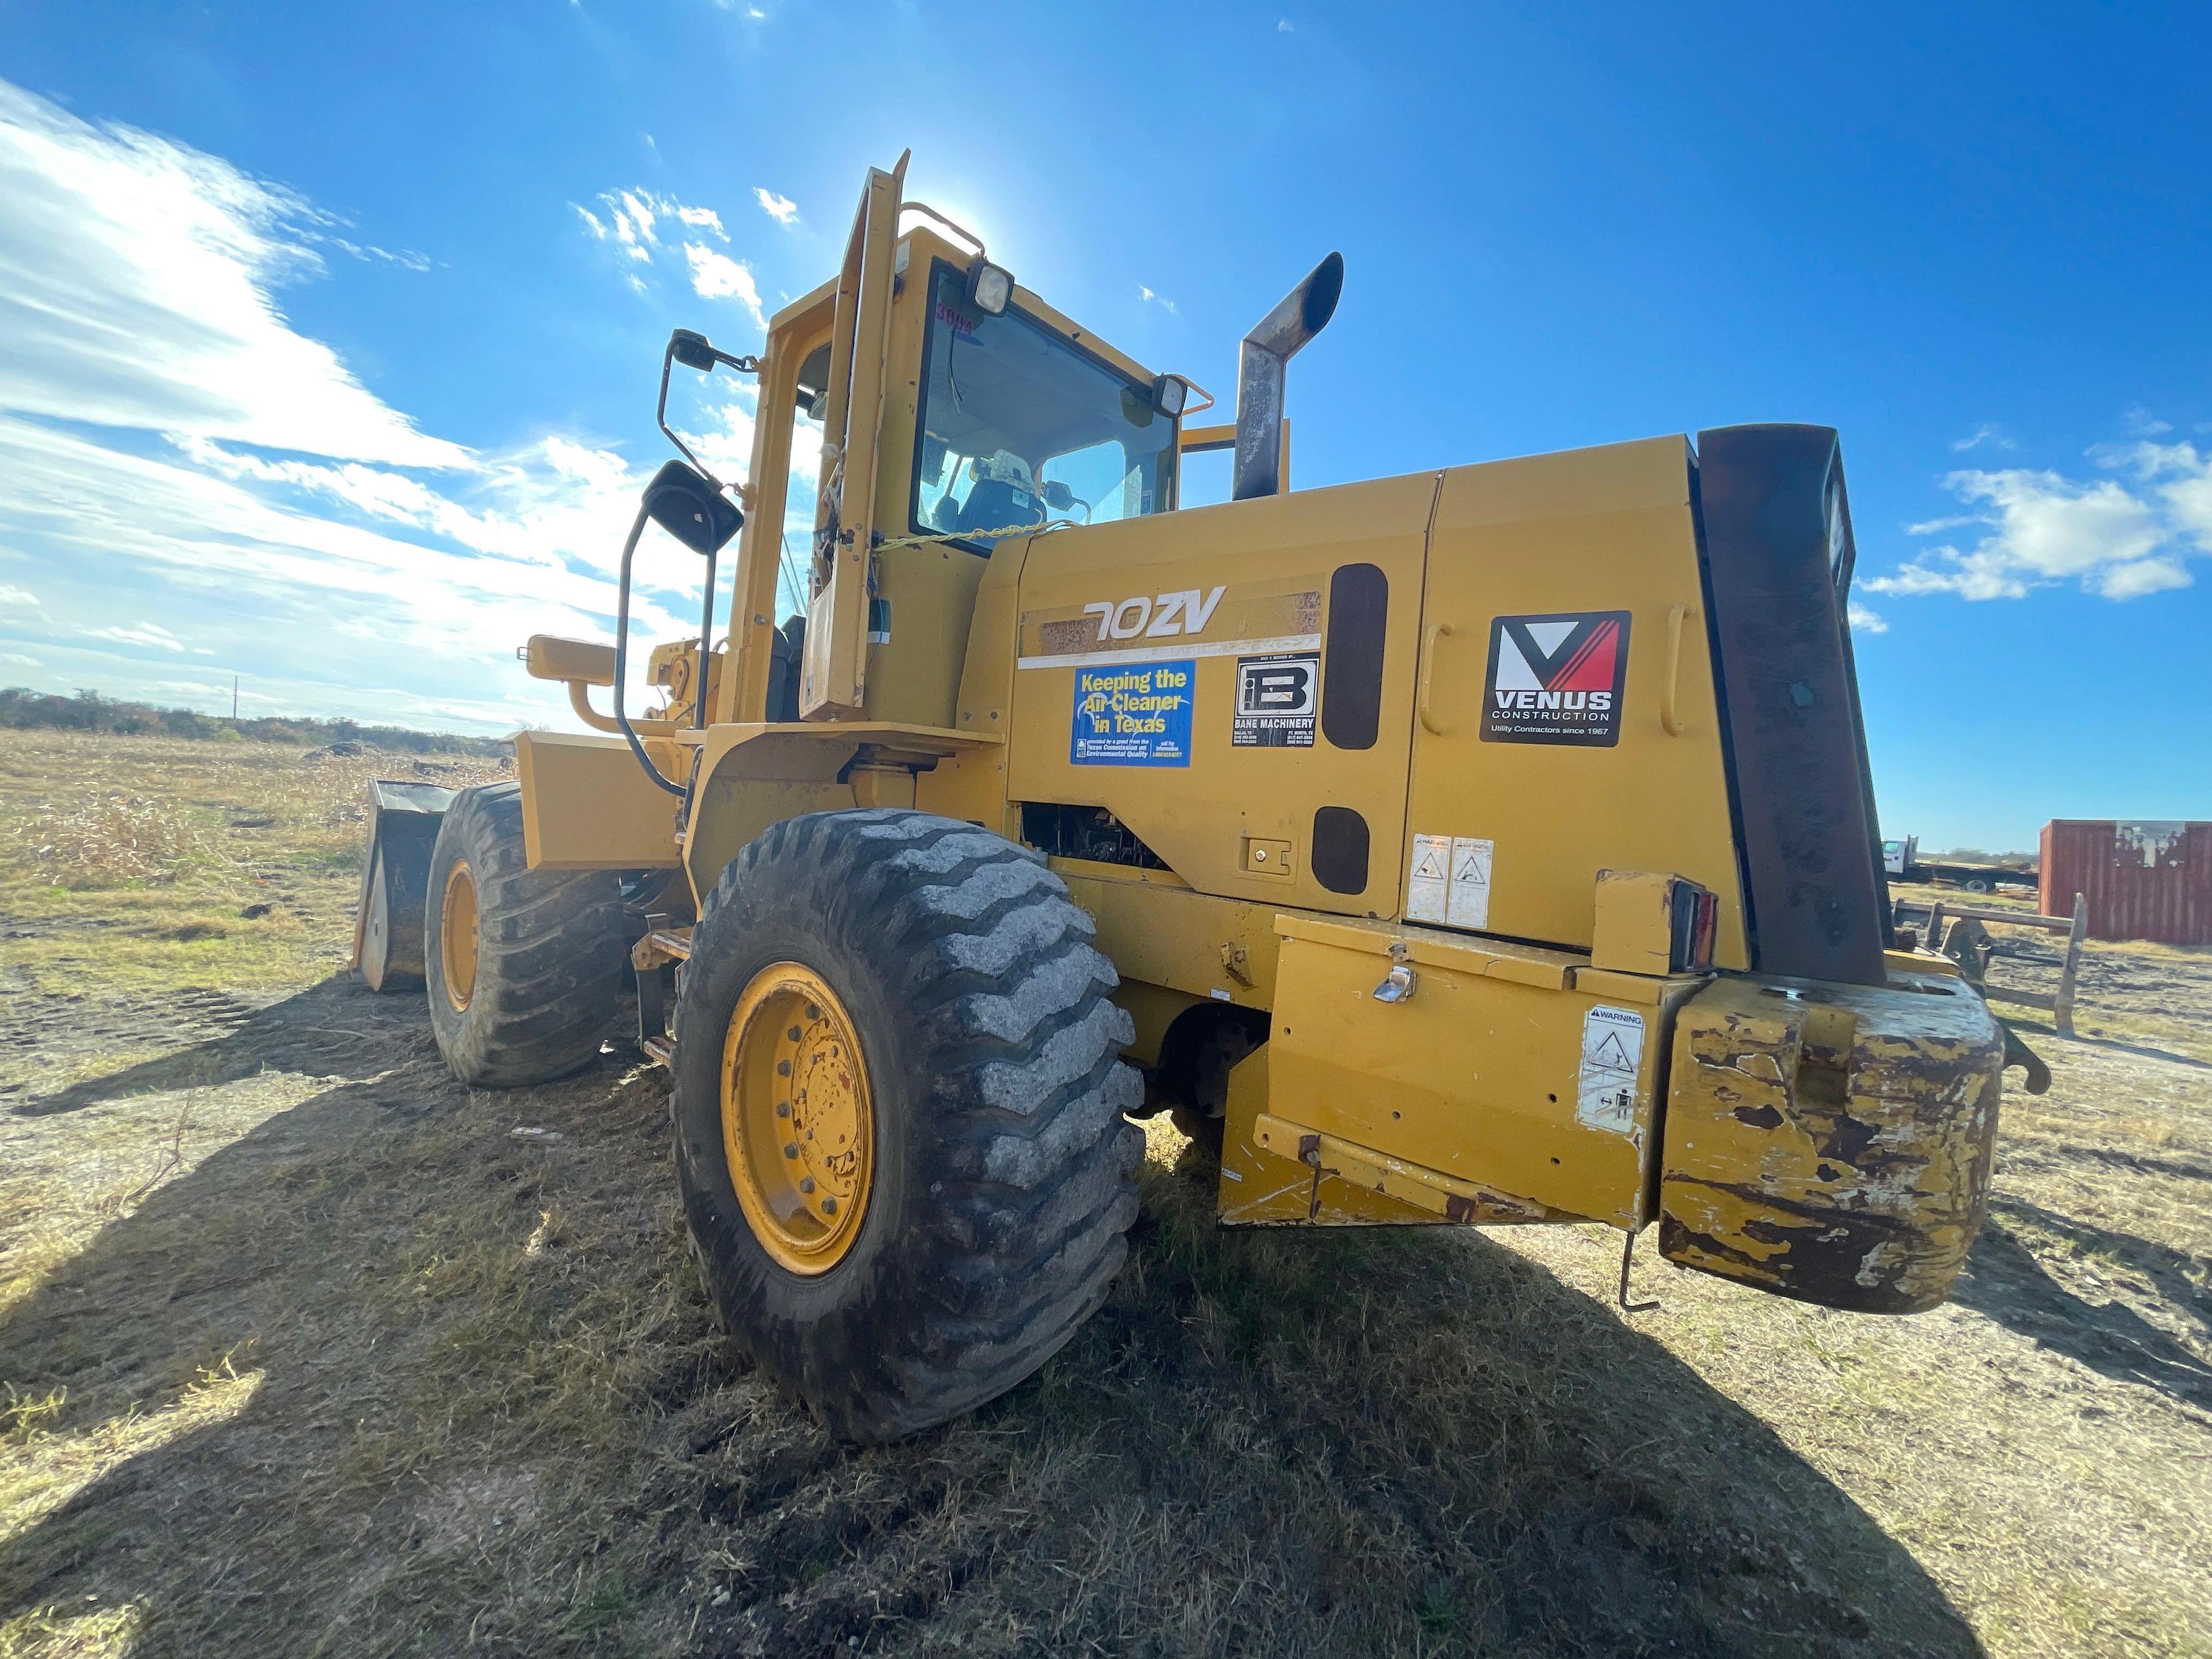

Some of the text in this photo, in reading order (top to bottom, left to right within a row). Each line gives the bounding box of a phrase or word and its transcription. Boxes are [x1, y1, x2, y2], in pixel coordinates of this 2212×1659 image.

[1084, 586, 1226, 641] 70ZV
[1082, 669, 1187, 694] Keeping the
[1084, 693, 1181, 713] Air Cleaner
[1495, 691, 1612, 710] VENUS
[1094, 714, 1165, 733] in Texas
[1235, 718, 1313, 729] BANE MACHINERY
[1492, 710, 1609, 721] CONSTRUCTION
[1491, 725, 1512, 733] Utility
[1514, 725, 1560, 734] Contractors
[1127, 751, 1148, 759] Quality
[1600, 1011, 1642, 1025] WARNING
